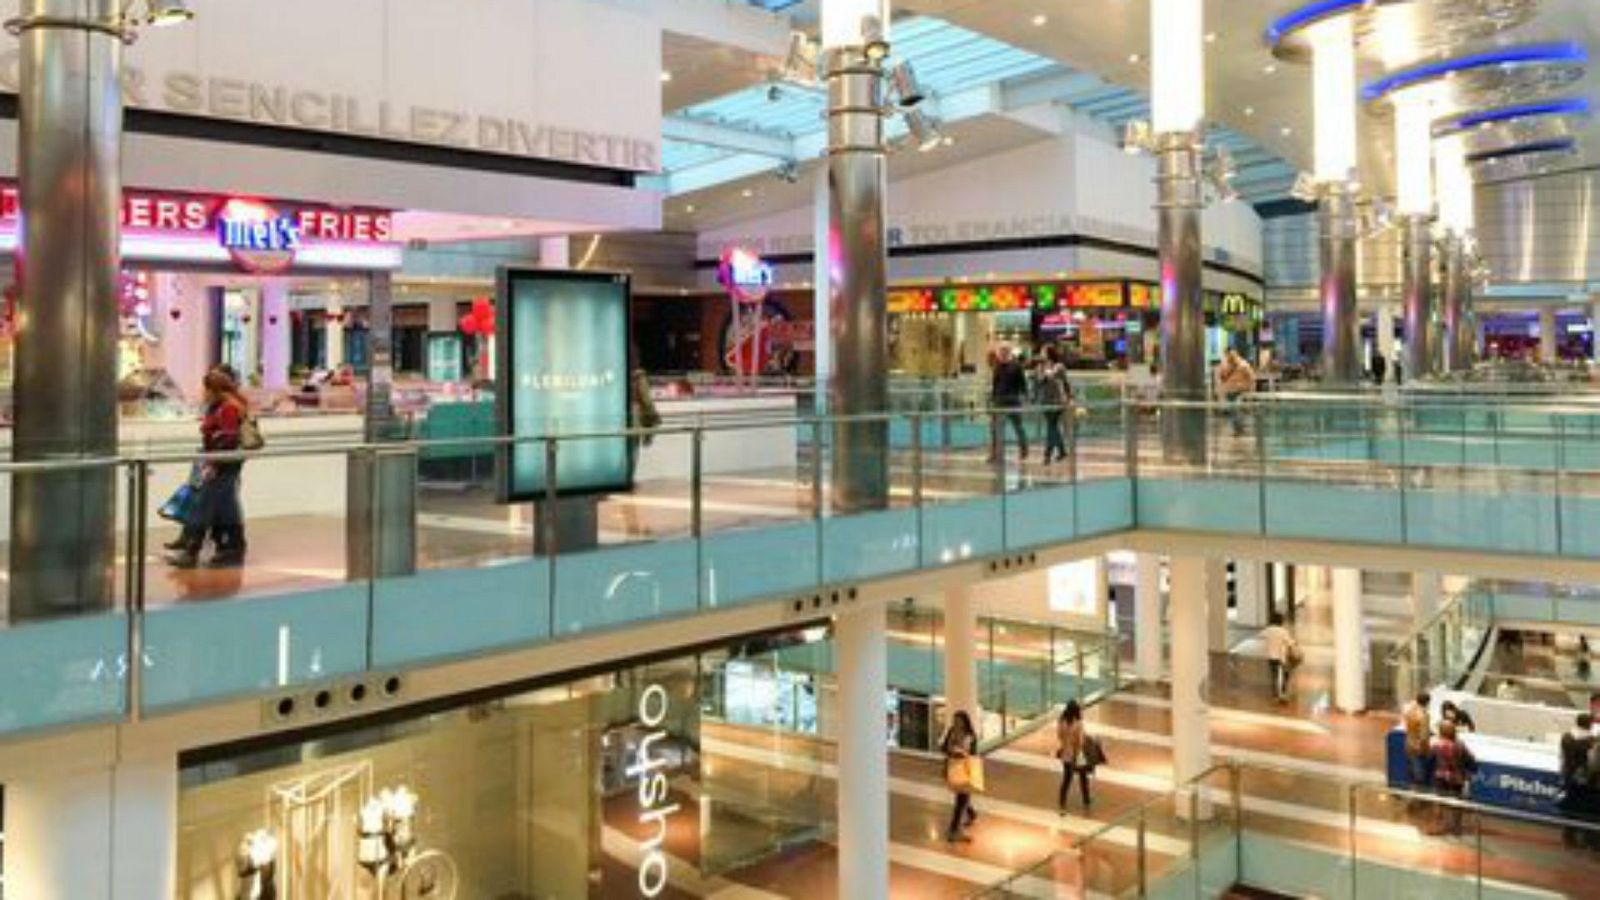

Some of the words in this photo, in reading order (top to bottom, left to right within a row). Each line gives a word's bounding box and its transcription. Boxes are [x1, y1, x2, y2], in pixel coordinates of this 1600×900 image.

[163, 73, 471, 146] SENCILLEZ
[477, 114, 658, 170] DIVERTIR
[119, 199, 207, 229] ERS
[300, 210, 391, 241] FRIES
